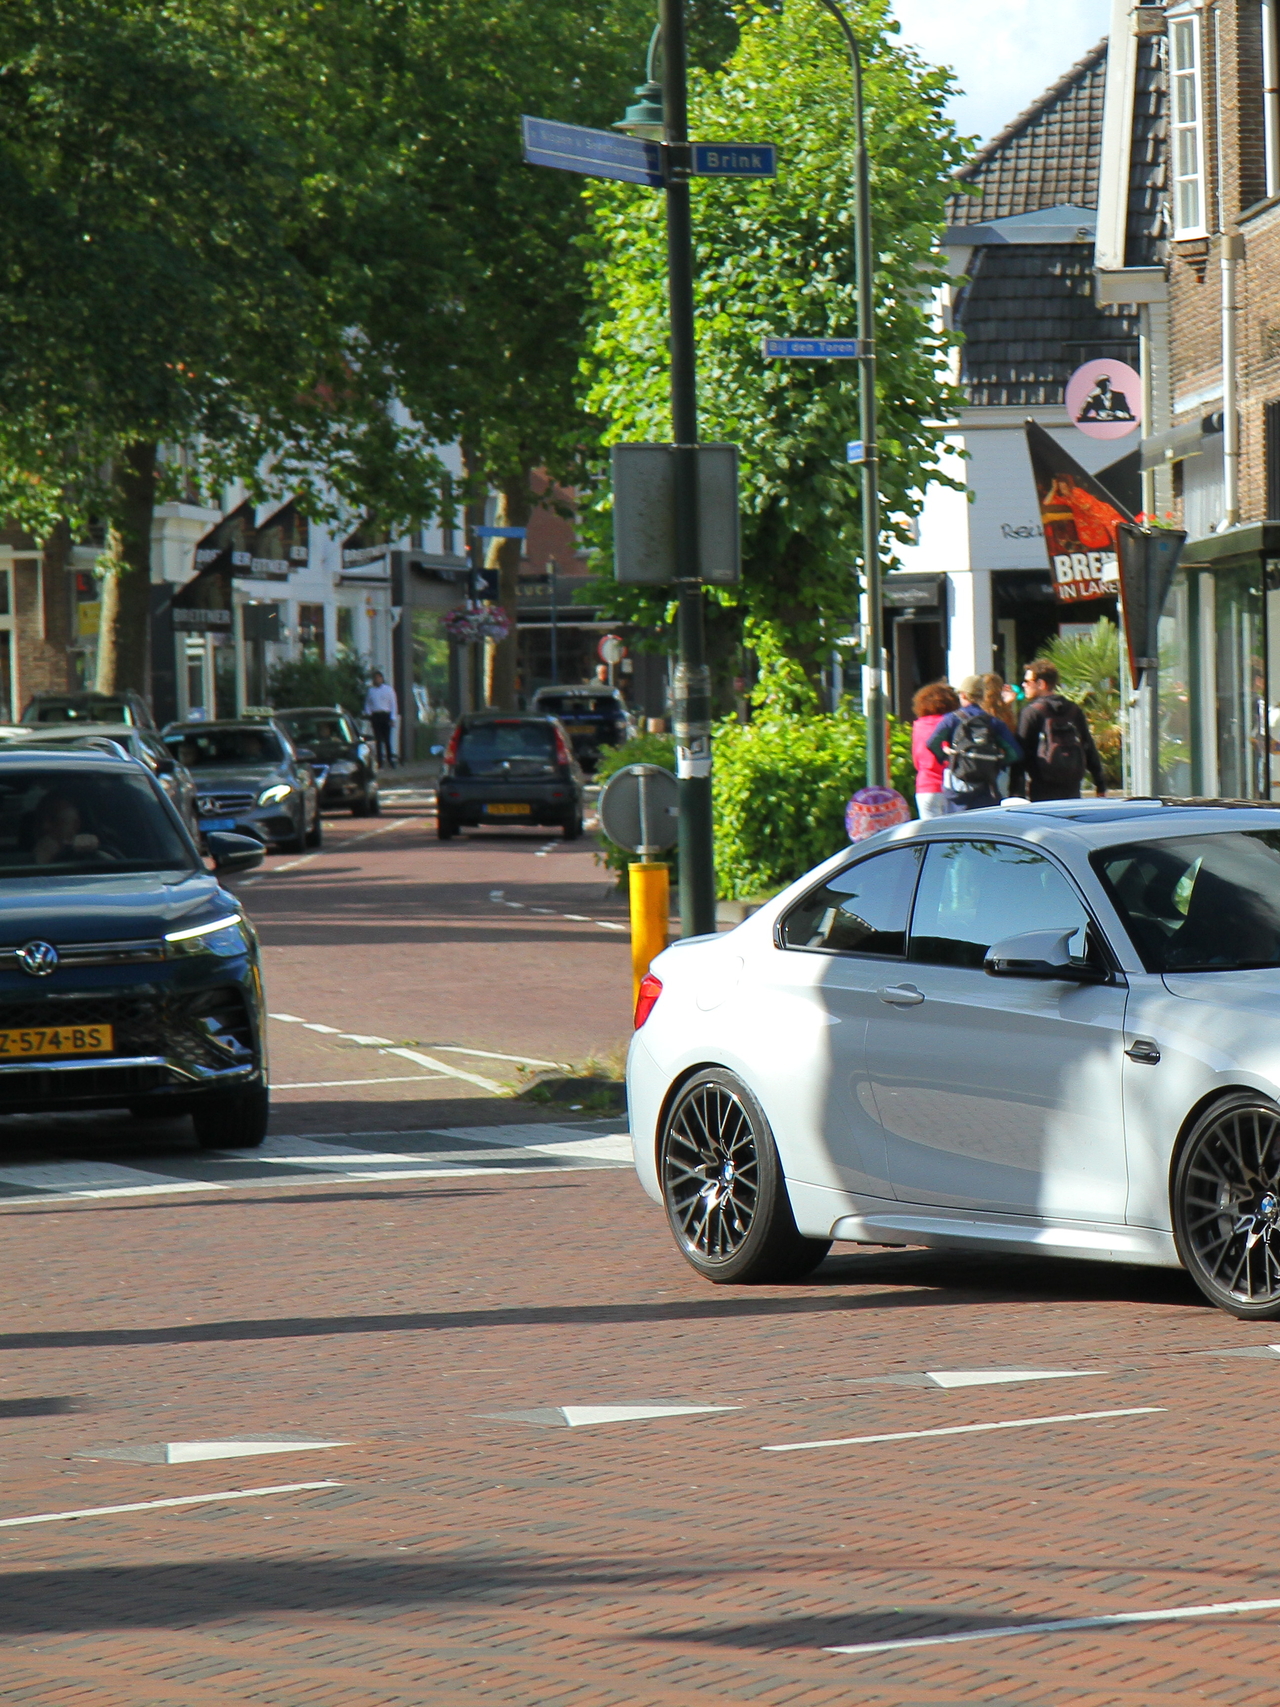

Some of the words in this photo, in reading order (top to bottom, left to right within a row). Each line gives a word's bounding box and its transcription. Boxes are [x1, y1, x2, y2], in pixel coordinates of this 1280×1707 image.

[707, 152, 762, 168] Brink
[791, 342, 815, 352] den
[818, 342, 854, 353] Toren
[1059, 584, 1077, 599] IN
